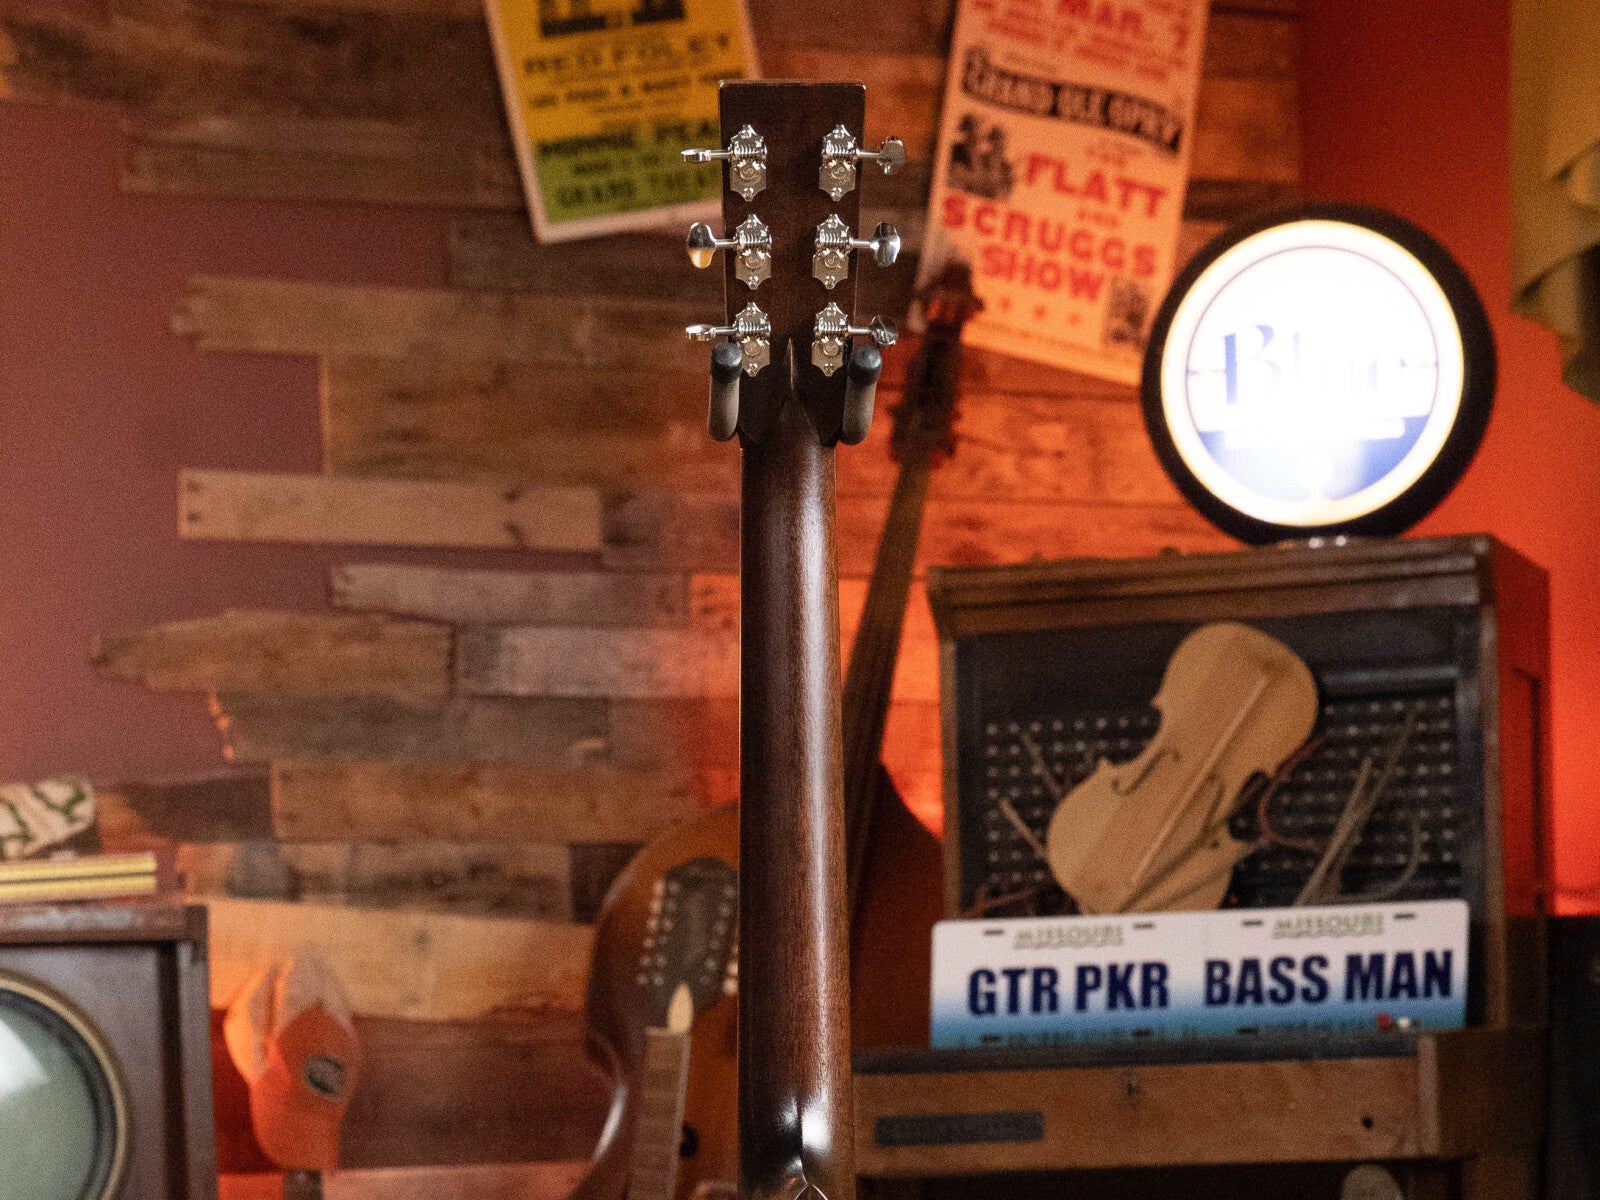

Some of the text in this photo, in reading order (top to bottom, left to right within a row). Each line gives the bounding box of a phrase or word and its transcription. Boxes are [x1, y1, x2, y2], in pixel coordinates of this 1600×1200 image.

[1025, 153, 1168, 218] FLATT
[942, 191, 1157, 278] SCRUGGS
[980, 244, 1103, 304] SHOW
[967, 960, 1170, 1018] GTR PKR
[1203, 949, 1455, 1008] BASS MAN
